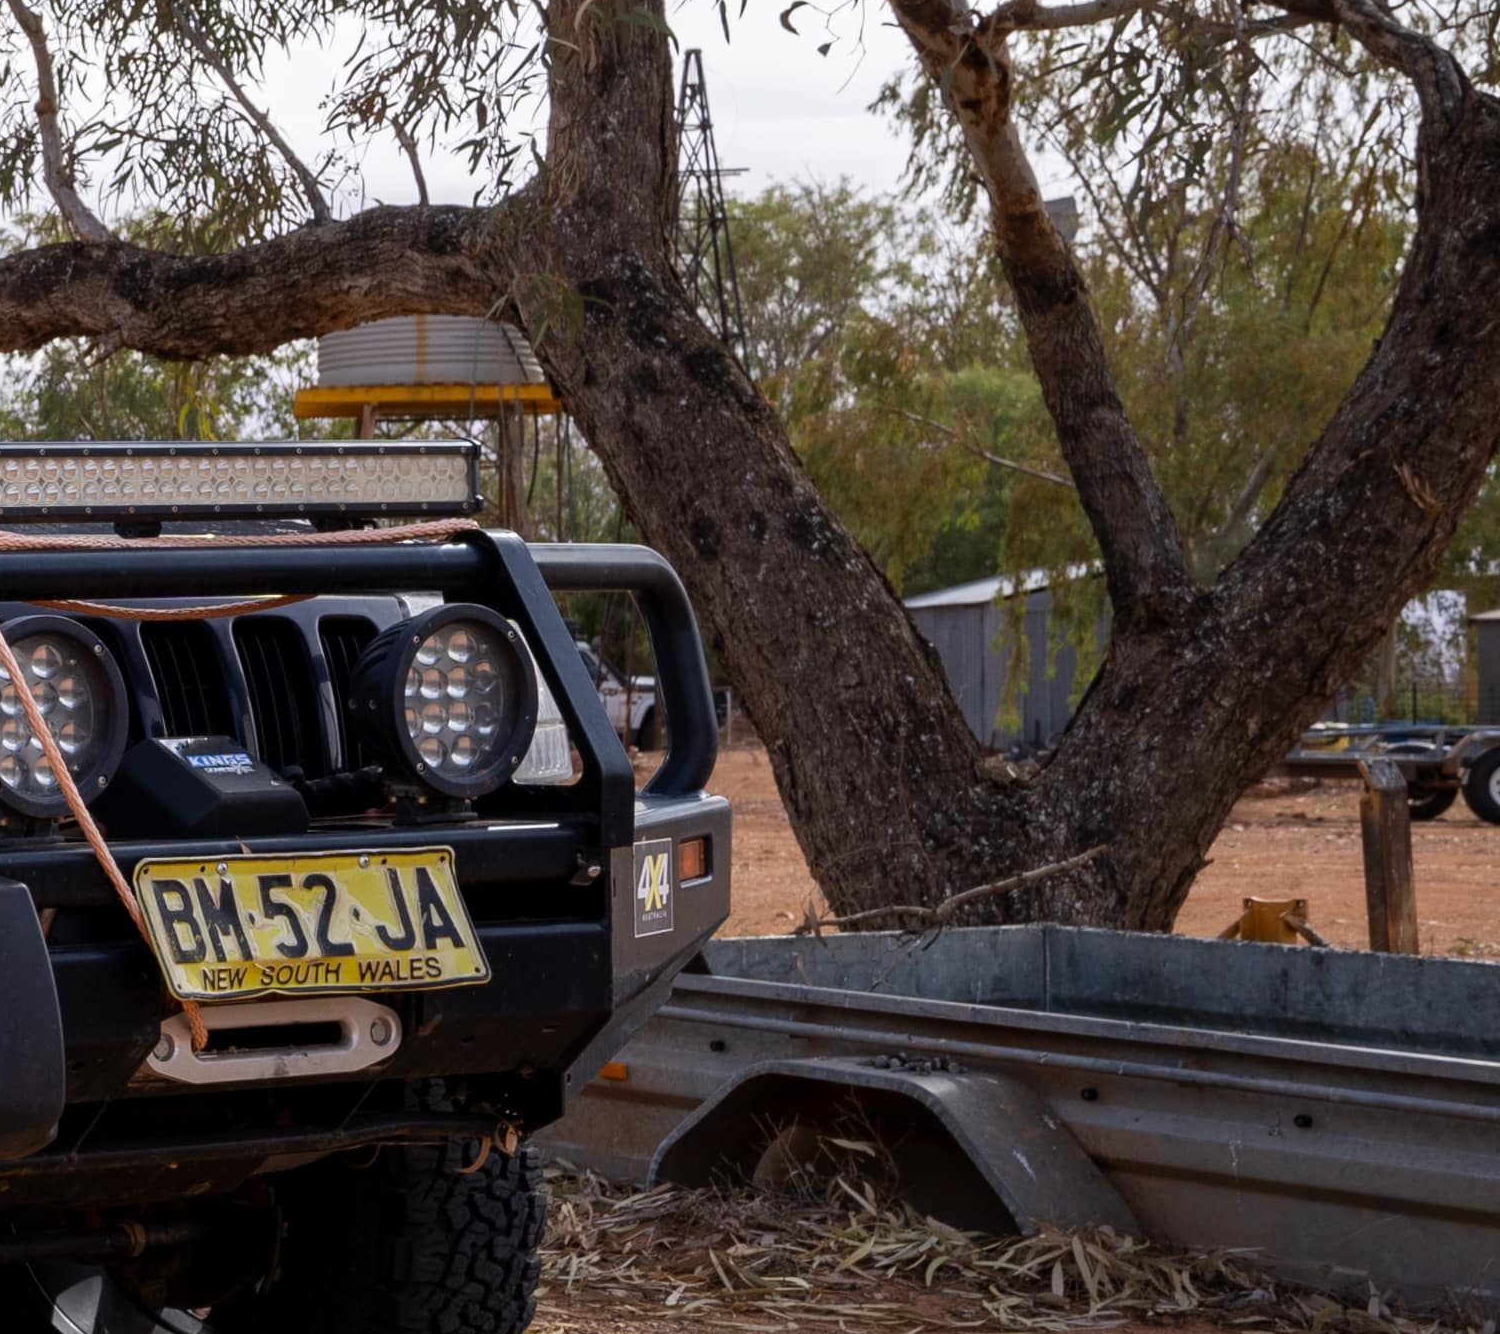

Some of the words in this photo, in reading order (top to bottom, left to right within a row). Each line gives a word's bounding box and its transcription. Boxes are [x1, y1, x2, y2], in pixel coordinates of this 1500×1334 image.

[187, 753, 252, 767] KINGS
[637, 853, 669, 912] 4X4
[202, 967, 248, 992] NEW
[261, 961, 342, 986] SOUTH
[358, 956, 443, 983] WALES
